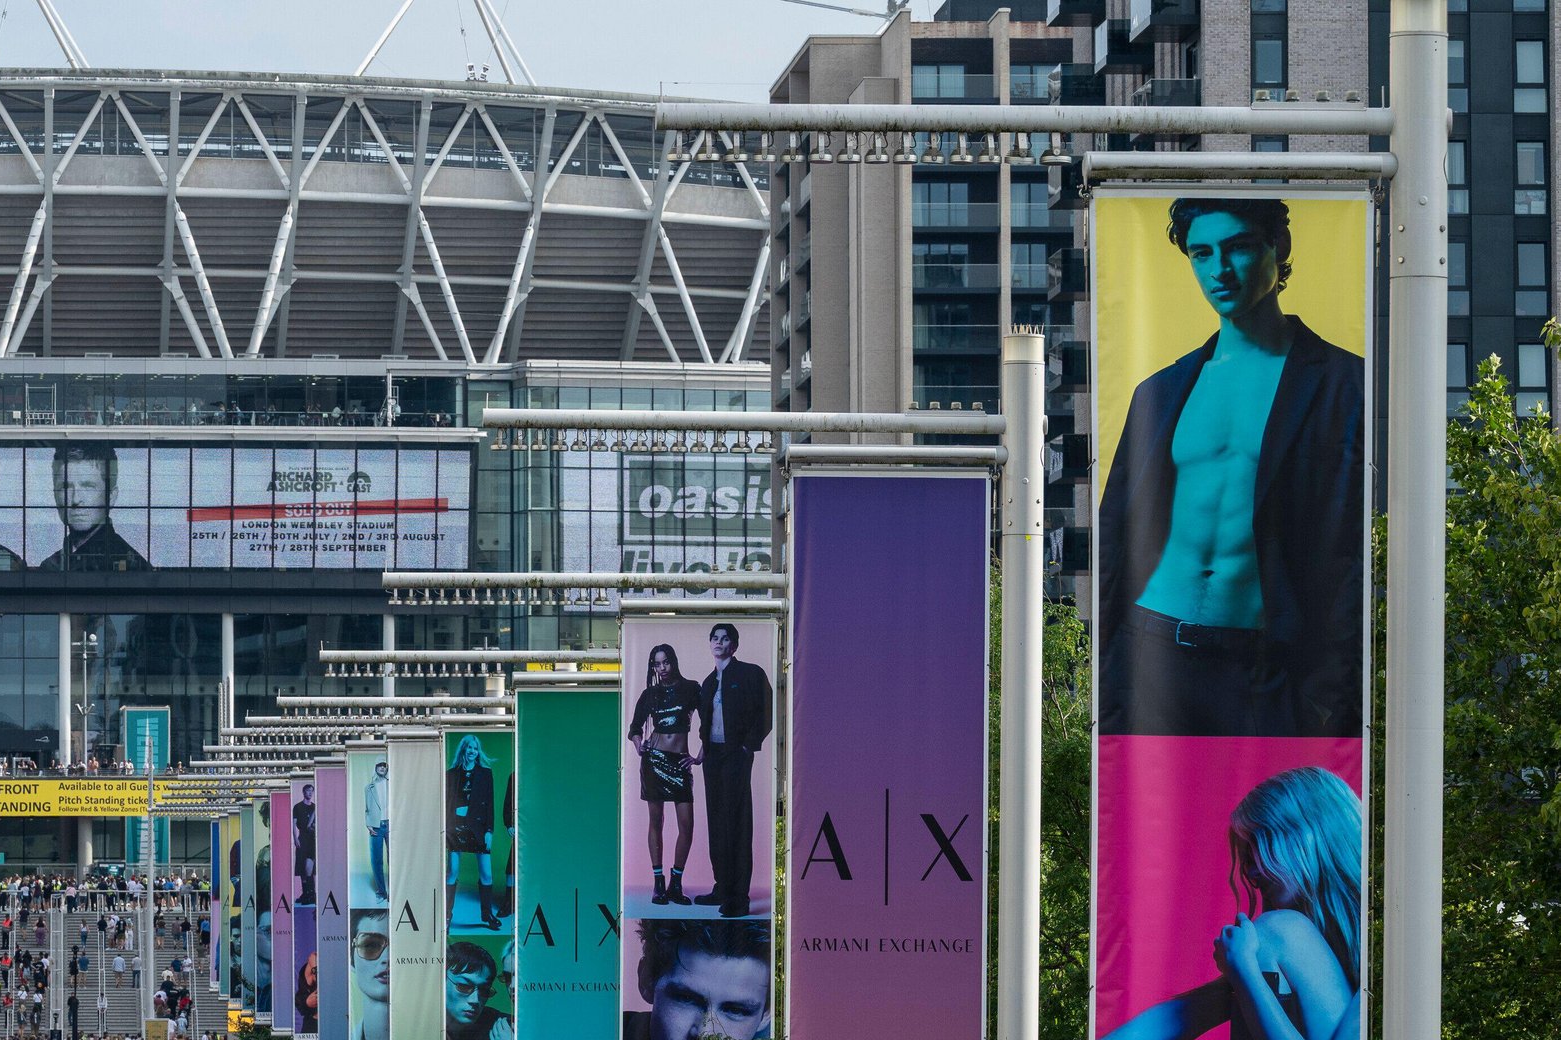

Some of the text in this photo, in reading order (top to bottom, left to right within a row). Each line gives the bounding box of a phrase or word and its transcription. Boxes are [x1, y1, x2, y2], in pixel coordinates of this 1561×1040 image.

[273, 471, 333, 482] RICHARD
[267, 481, 337, 492] ASHCROFT
[347, 484, 371, 493] CAST
[285, 502, 353, 517] SOLD OUT
[242, 521, 395, 530] LONDON WEMBLEY STADIUM
[192, 532, 446, 541] 25TH 26TH 30TH JULY 2ND 3RD AUGUST
[322, 544, 386, 552] SEPTEMBER
[58, 782, 102, 791] Available
[103, 783, 114, 791] to
[116, 782, 127, 791] all
[129, 782, 161, 791] Guets
[58, 796, 157, 807] Pitch Standing tickes
[800, 938, 974, 953] ARMANI EXCHANGE
[396, 957, 428, 965] ARMANI
[523, 982, 621, 992] ARMANI EXCHAN
